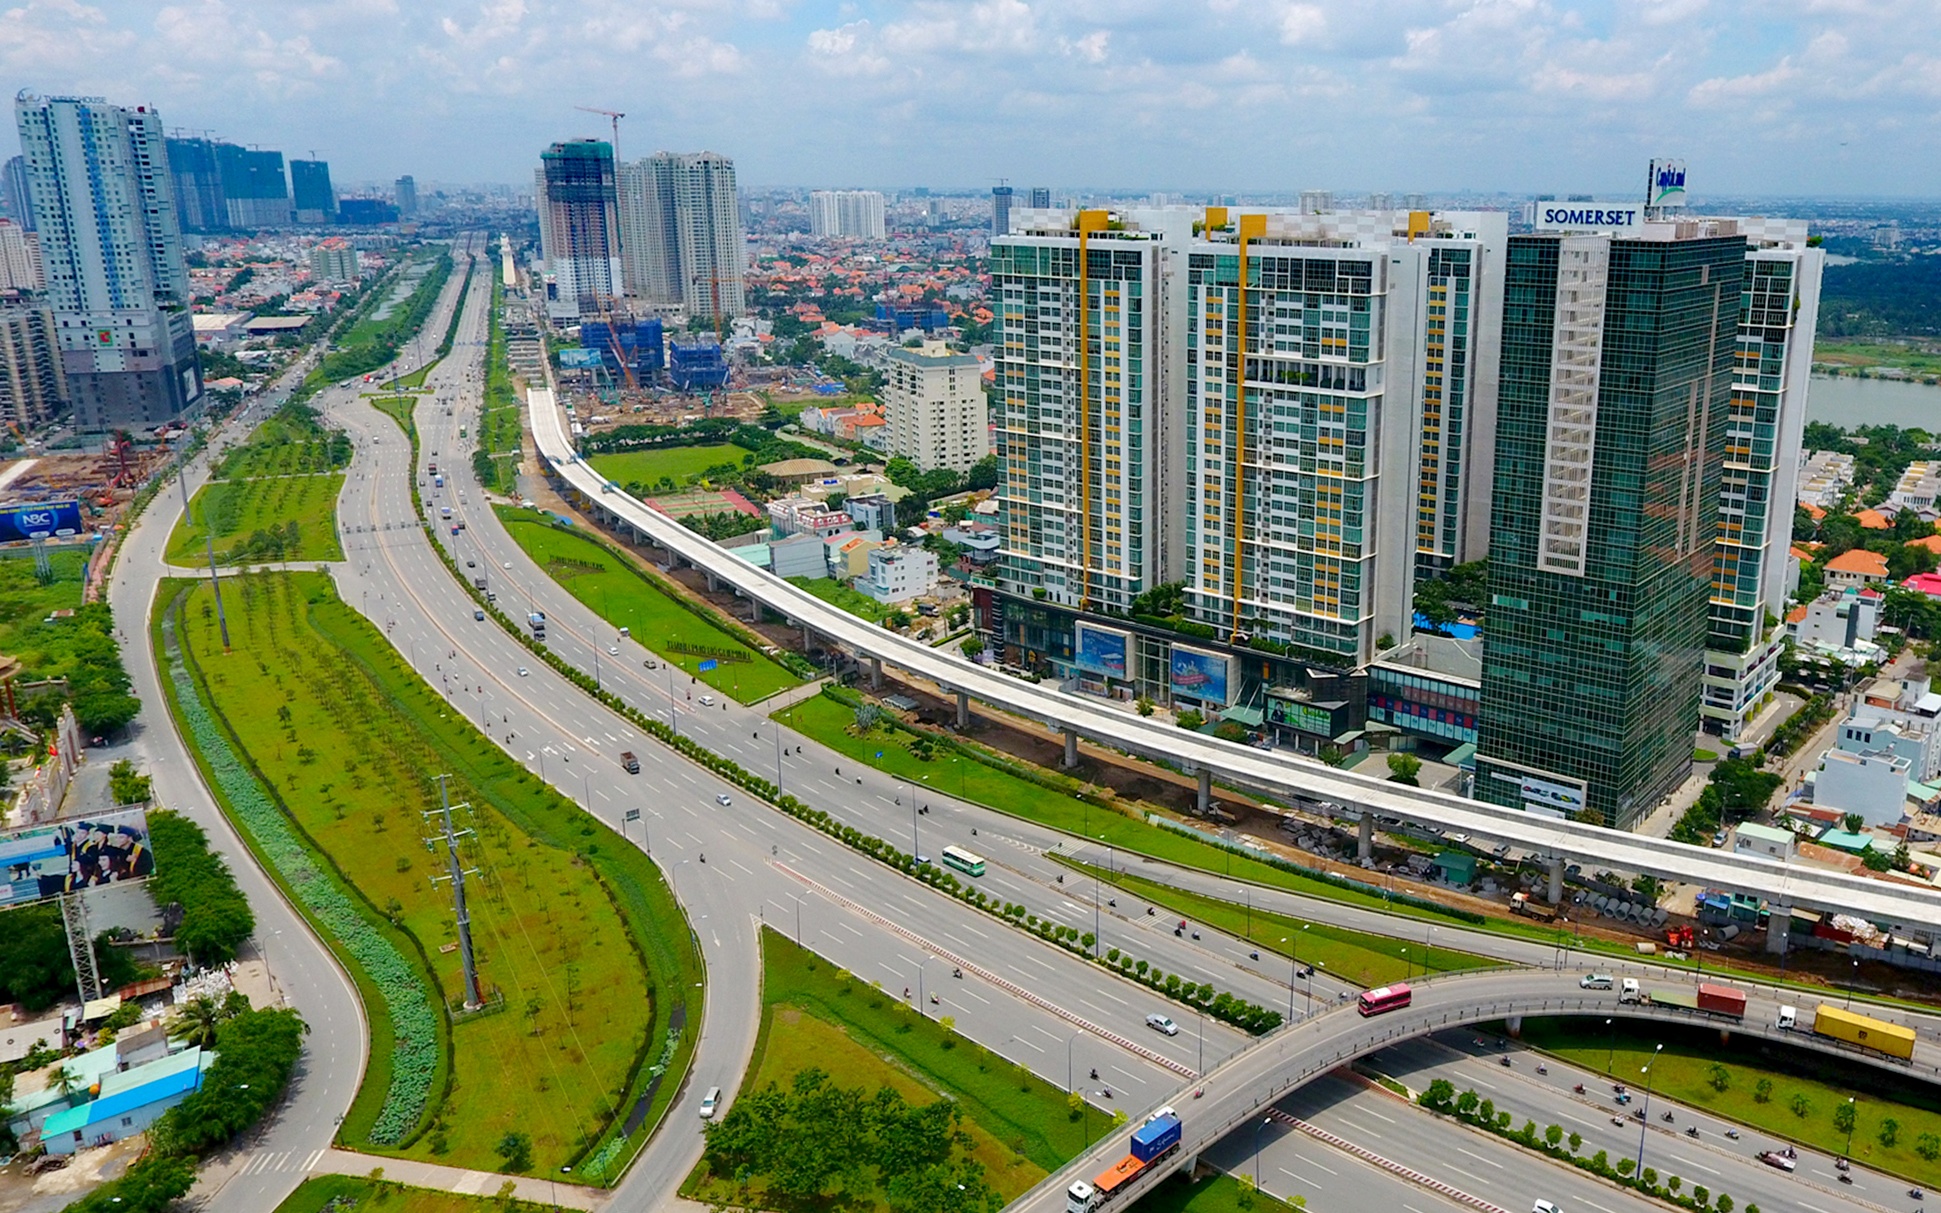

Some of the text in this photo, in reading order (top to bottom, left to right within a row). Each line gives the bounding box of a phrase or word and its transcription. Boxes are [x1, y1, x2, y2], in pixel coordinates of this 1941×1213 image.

[79, 96, 107, 104] HOUSE
[1545, 209, 1636, 226] SOMERSET
[22, 512, 50, 525] NBC
